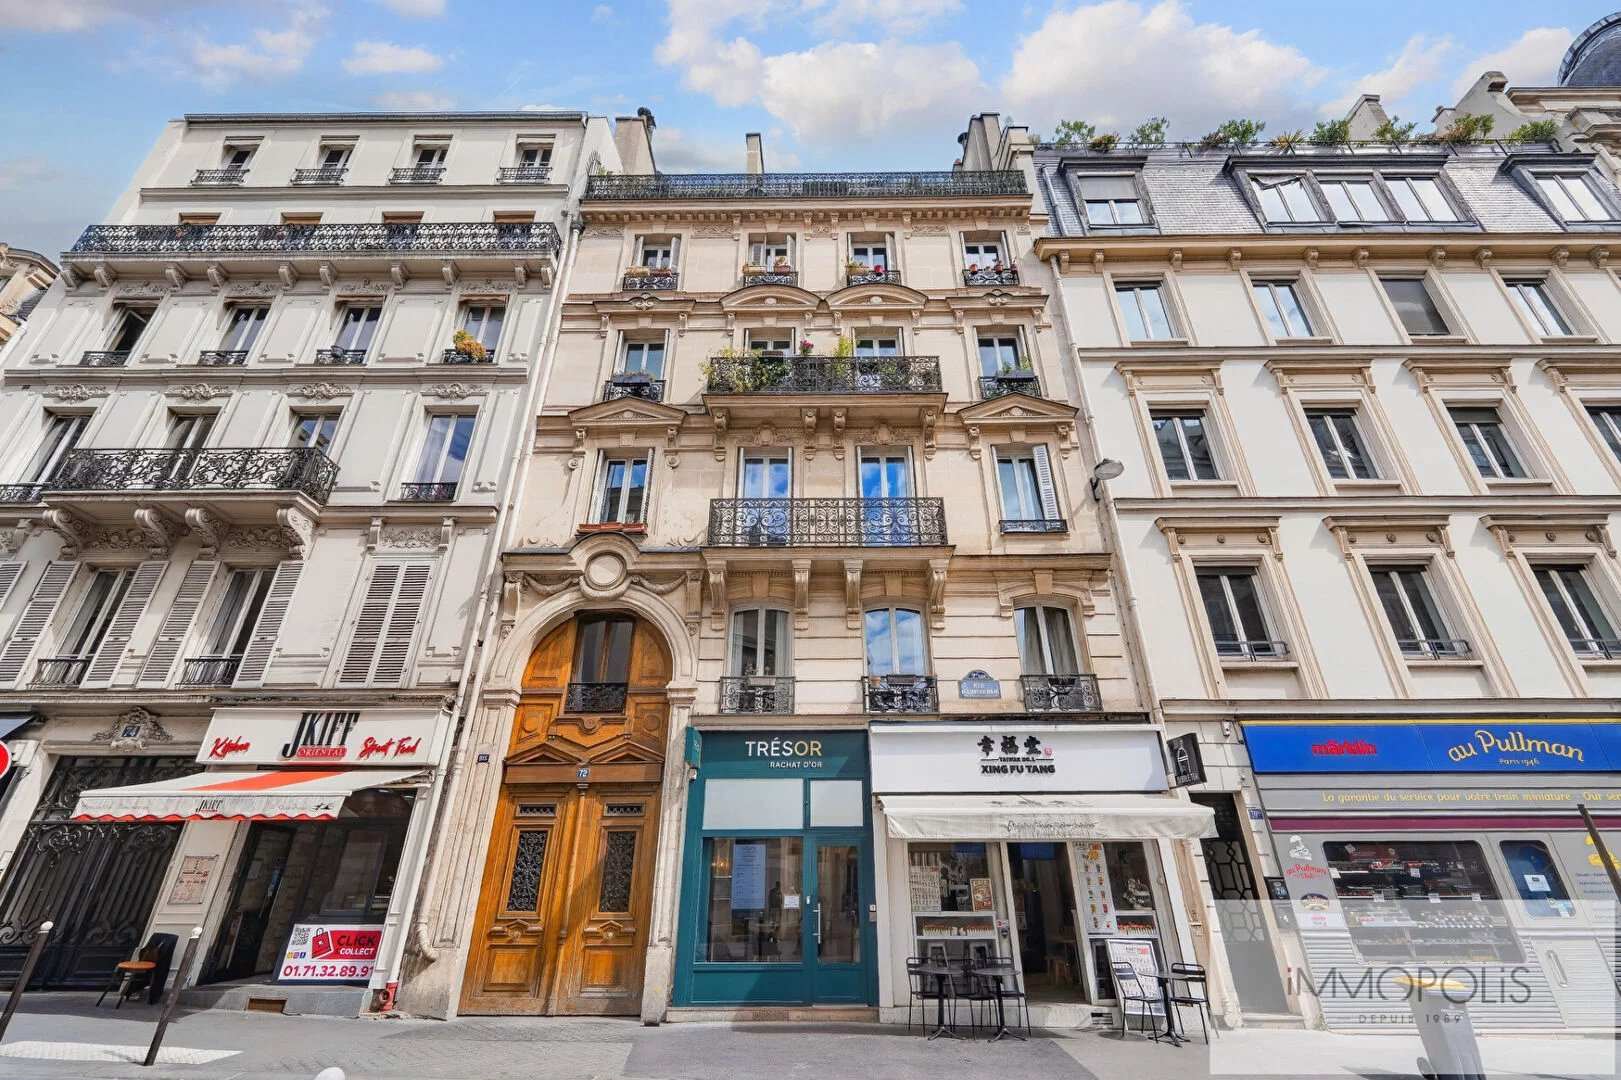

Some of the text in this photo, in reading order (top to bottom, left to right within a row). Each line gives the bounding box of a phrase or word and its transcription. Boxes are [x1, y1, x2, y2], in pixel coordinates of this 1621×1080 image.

[282, 711, 361, 759] JKIFF
[359, 736, 422, 760] Street Food
[744, 736, 822, 757] TRÉSOR
[1449, 730, 1585, 763] au Pullman
[769, 761, 822, 769] RACHAT D'OR
[981, 765, 1056, 774] XING FU TANG
[1338, 791, 1379, 804] garantie
[1401, 792, 1434, 801] service
[1437, 793, 1461, 804] pour
[1522, 791, 1572, 801] miniature
[336, 935, 376, 947] CLICK
[340, 948, 375, 956] COLLECT
